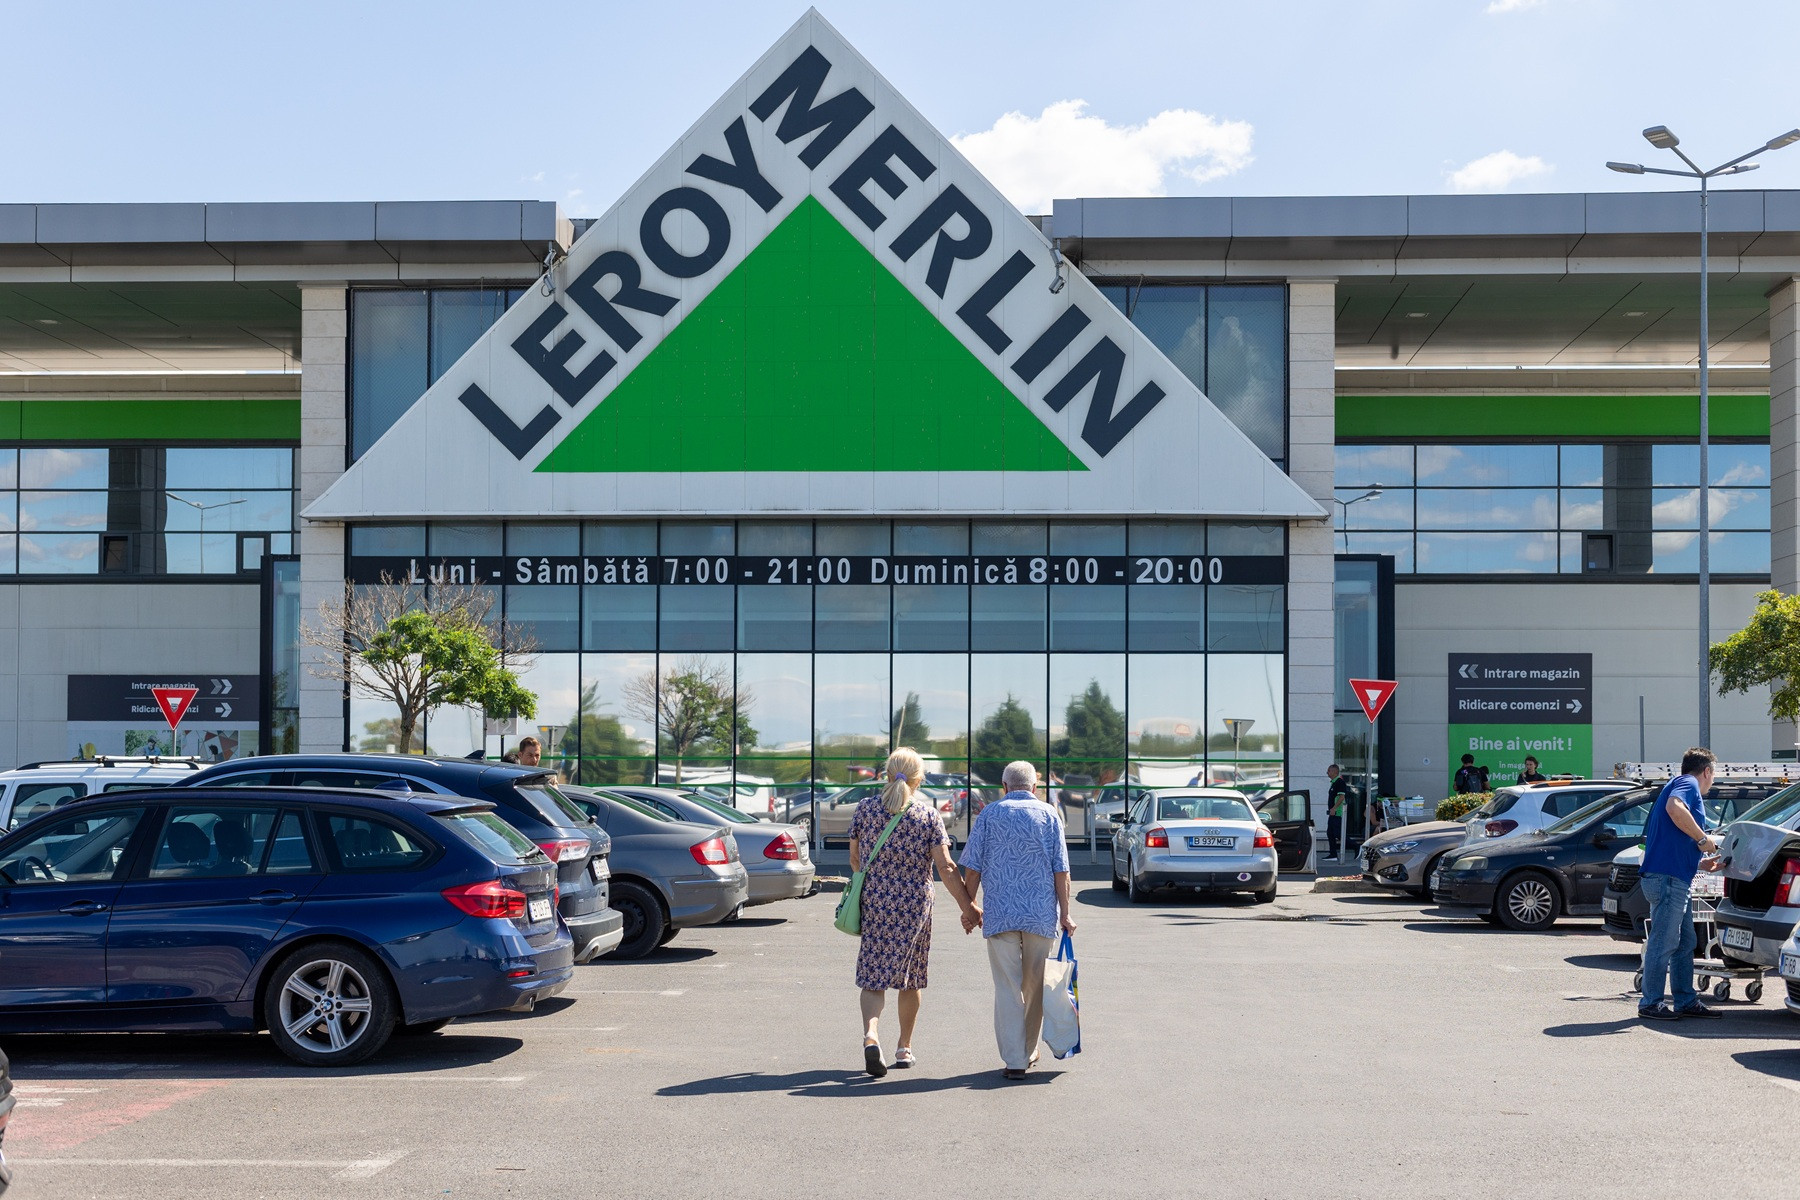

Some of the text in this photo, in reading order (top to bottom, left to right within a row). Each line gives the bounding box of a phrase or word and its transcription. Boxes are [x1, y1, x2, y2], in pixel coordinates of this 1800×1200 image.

[748, 44, 1167, 459] MERLIN
[458, 115, 783, 461] LEROY
[410, 559, 476, 584] Luni
[516, 557, 649, 584] Sâmbătă
[664, 558, 728, 584] 7:00
[767, 558, 850, 584] 21:00
[871, 557, 1017, 584] Duminică
[1029, 557, 1099, 584] 8:00
[1135, 557, 1222, 584] 20:00
[1484, 668, 1580, 681] Intrare magazin
[131, 682, 160, 690] Intrare
[1459, 699, 1560, 710] Ridicare comenzi
[1469, 736, 1503, 750] Bine
[1506, 736, 1520, 750] ai
[1523, 736, 1564, 750] venit
[1194, 837, 1231, 846] B 937 MEA
[1726, 929, 1736, 943] PH
